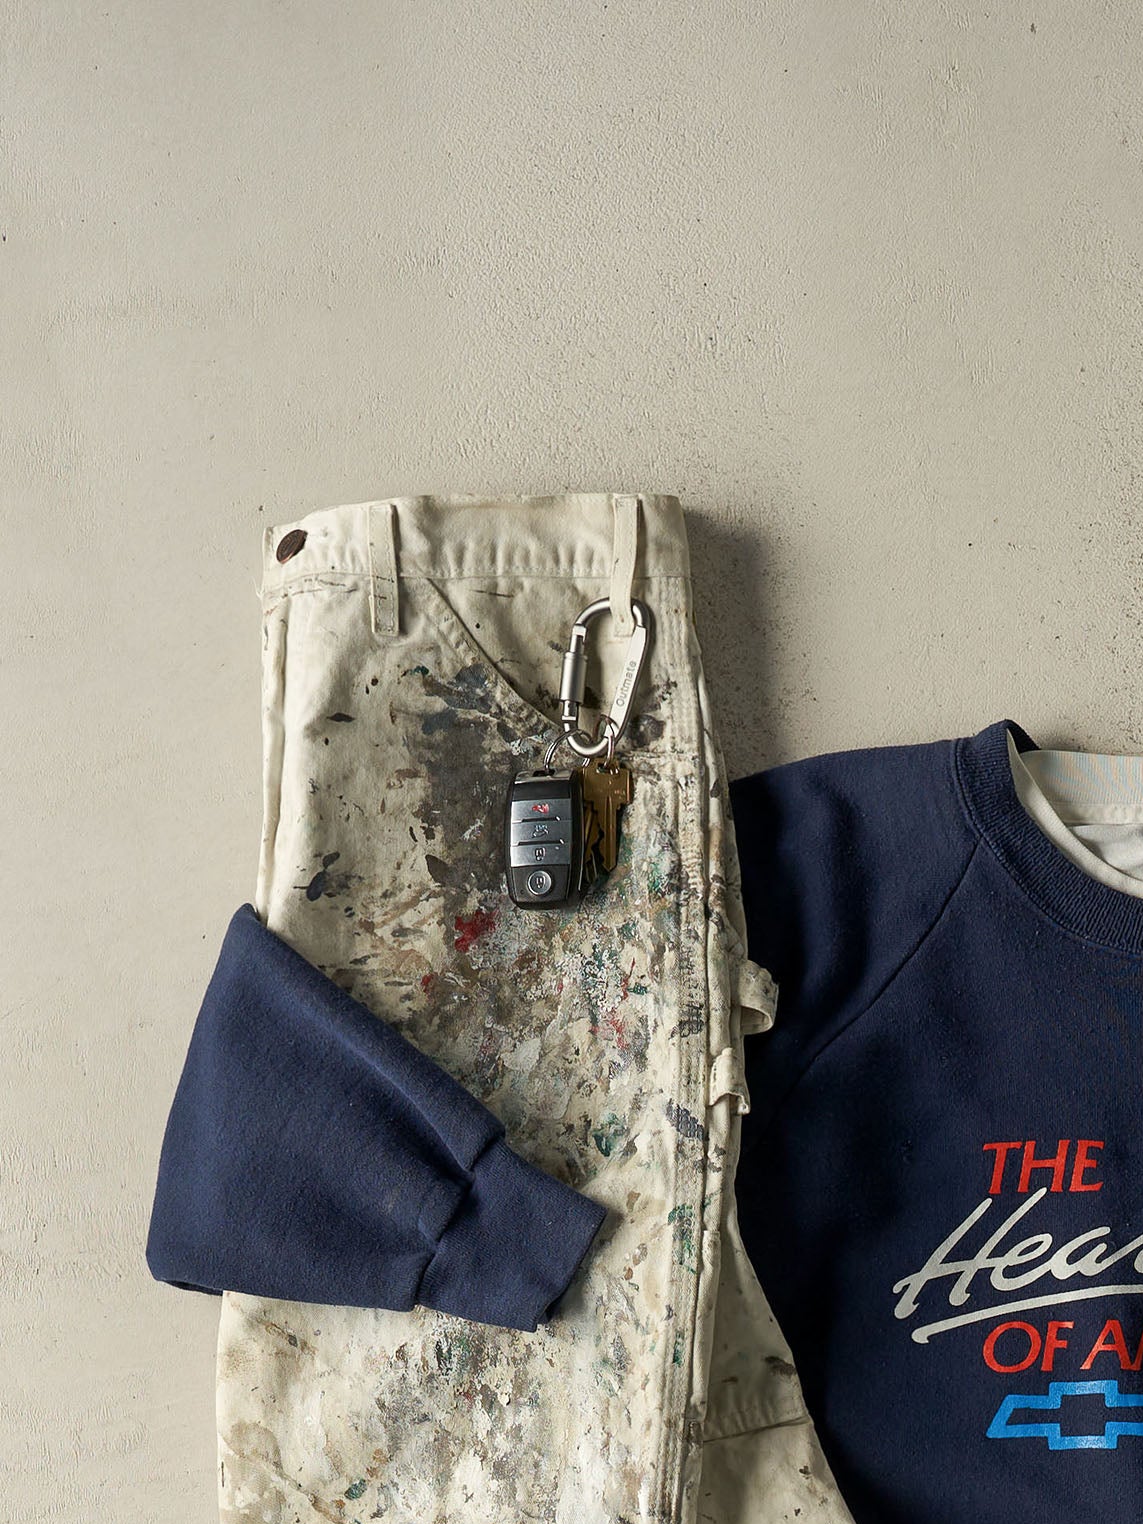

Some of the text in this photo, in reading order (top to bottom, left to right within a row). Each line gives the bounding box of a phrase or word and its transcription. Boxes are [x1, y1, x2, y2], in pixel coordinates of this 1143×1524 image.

[616, 660, 637, 707] Outmate
[983, 1140, 1104, 1194] THE
[983, 1321, 1074, 1372] OF
